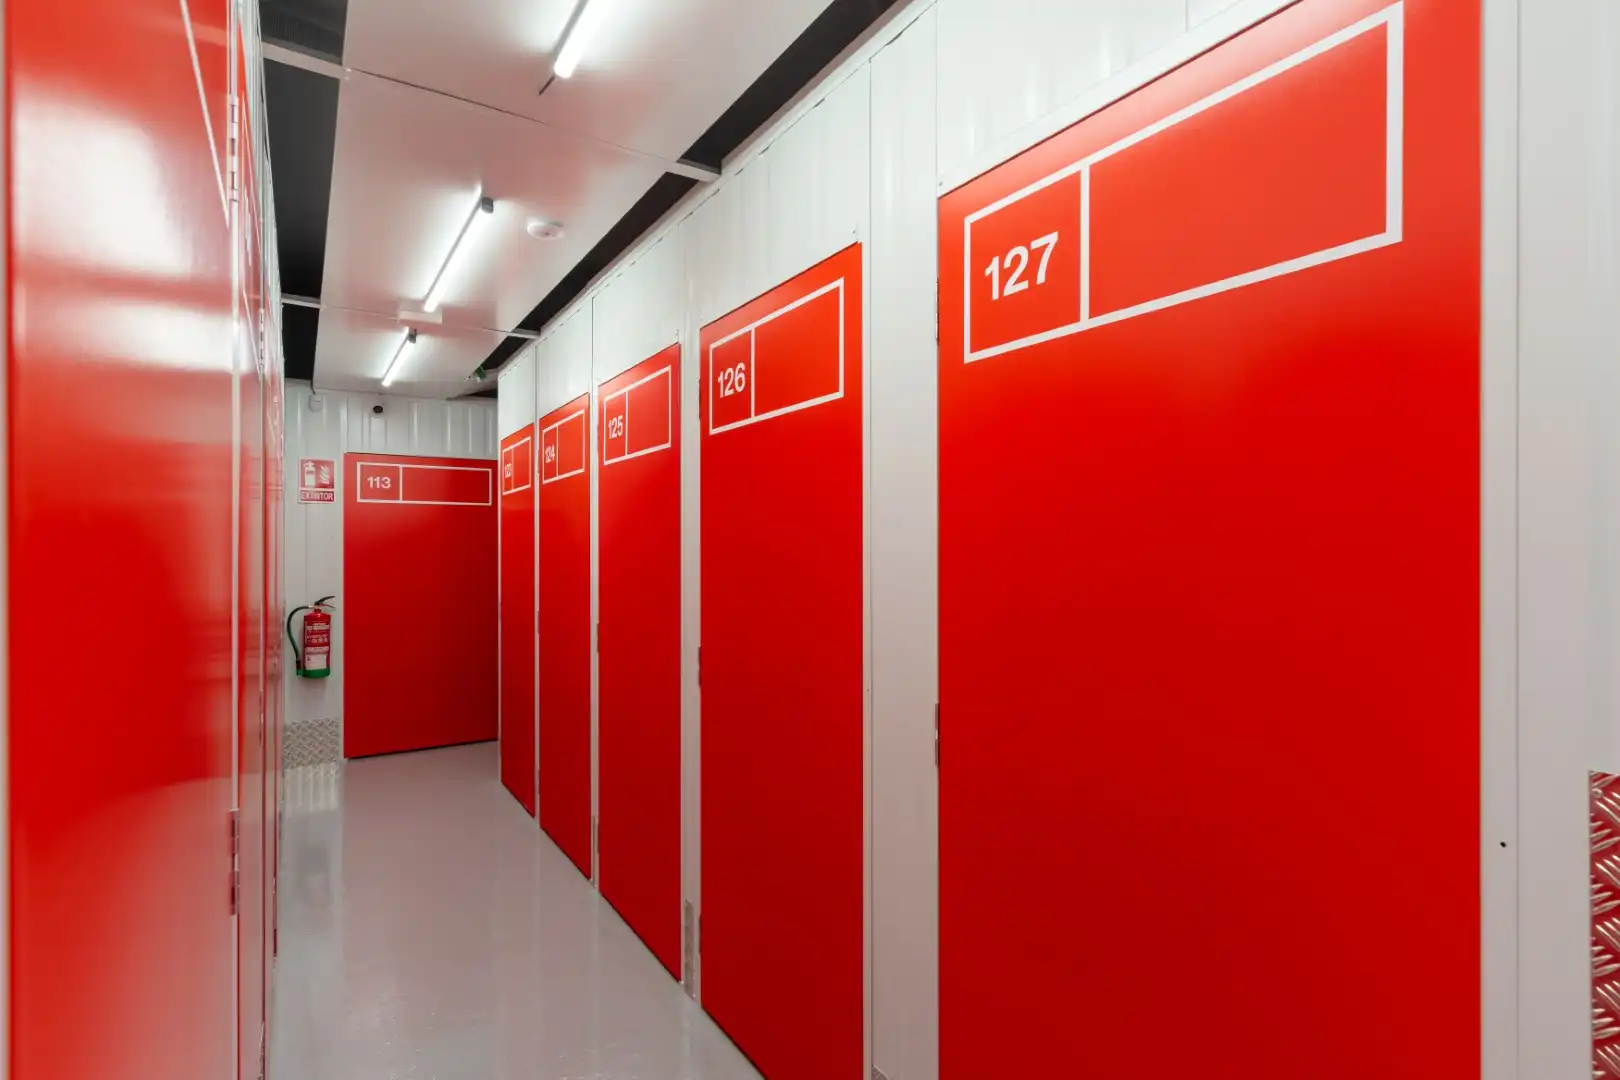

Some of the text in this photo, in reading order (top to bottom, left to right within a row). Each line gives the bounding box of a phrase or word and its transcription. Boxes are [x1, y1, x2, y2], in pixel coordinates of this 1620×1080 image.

[984, 231, 1058, 300] 127
[717, 362, 746, 398] 126
[607, 415, 624, 439] 125
[367, 476, 391, 489] 113
[301, 491, 334, 501] EXTINTOR
